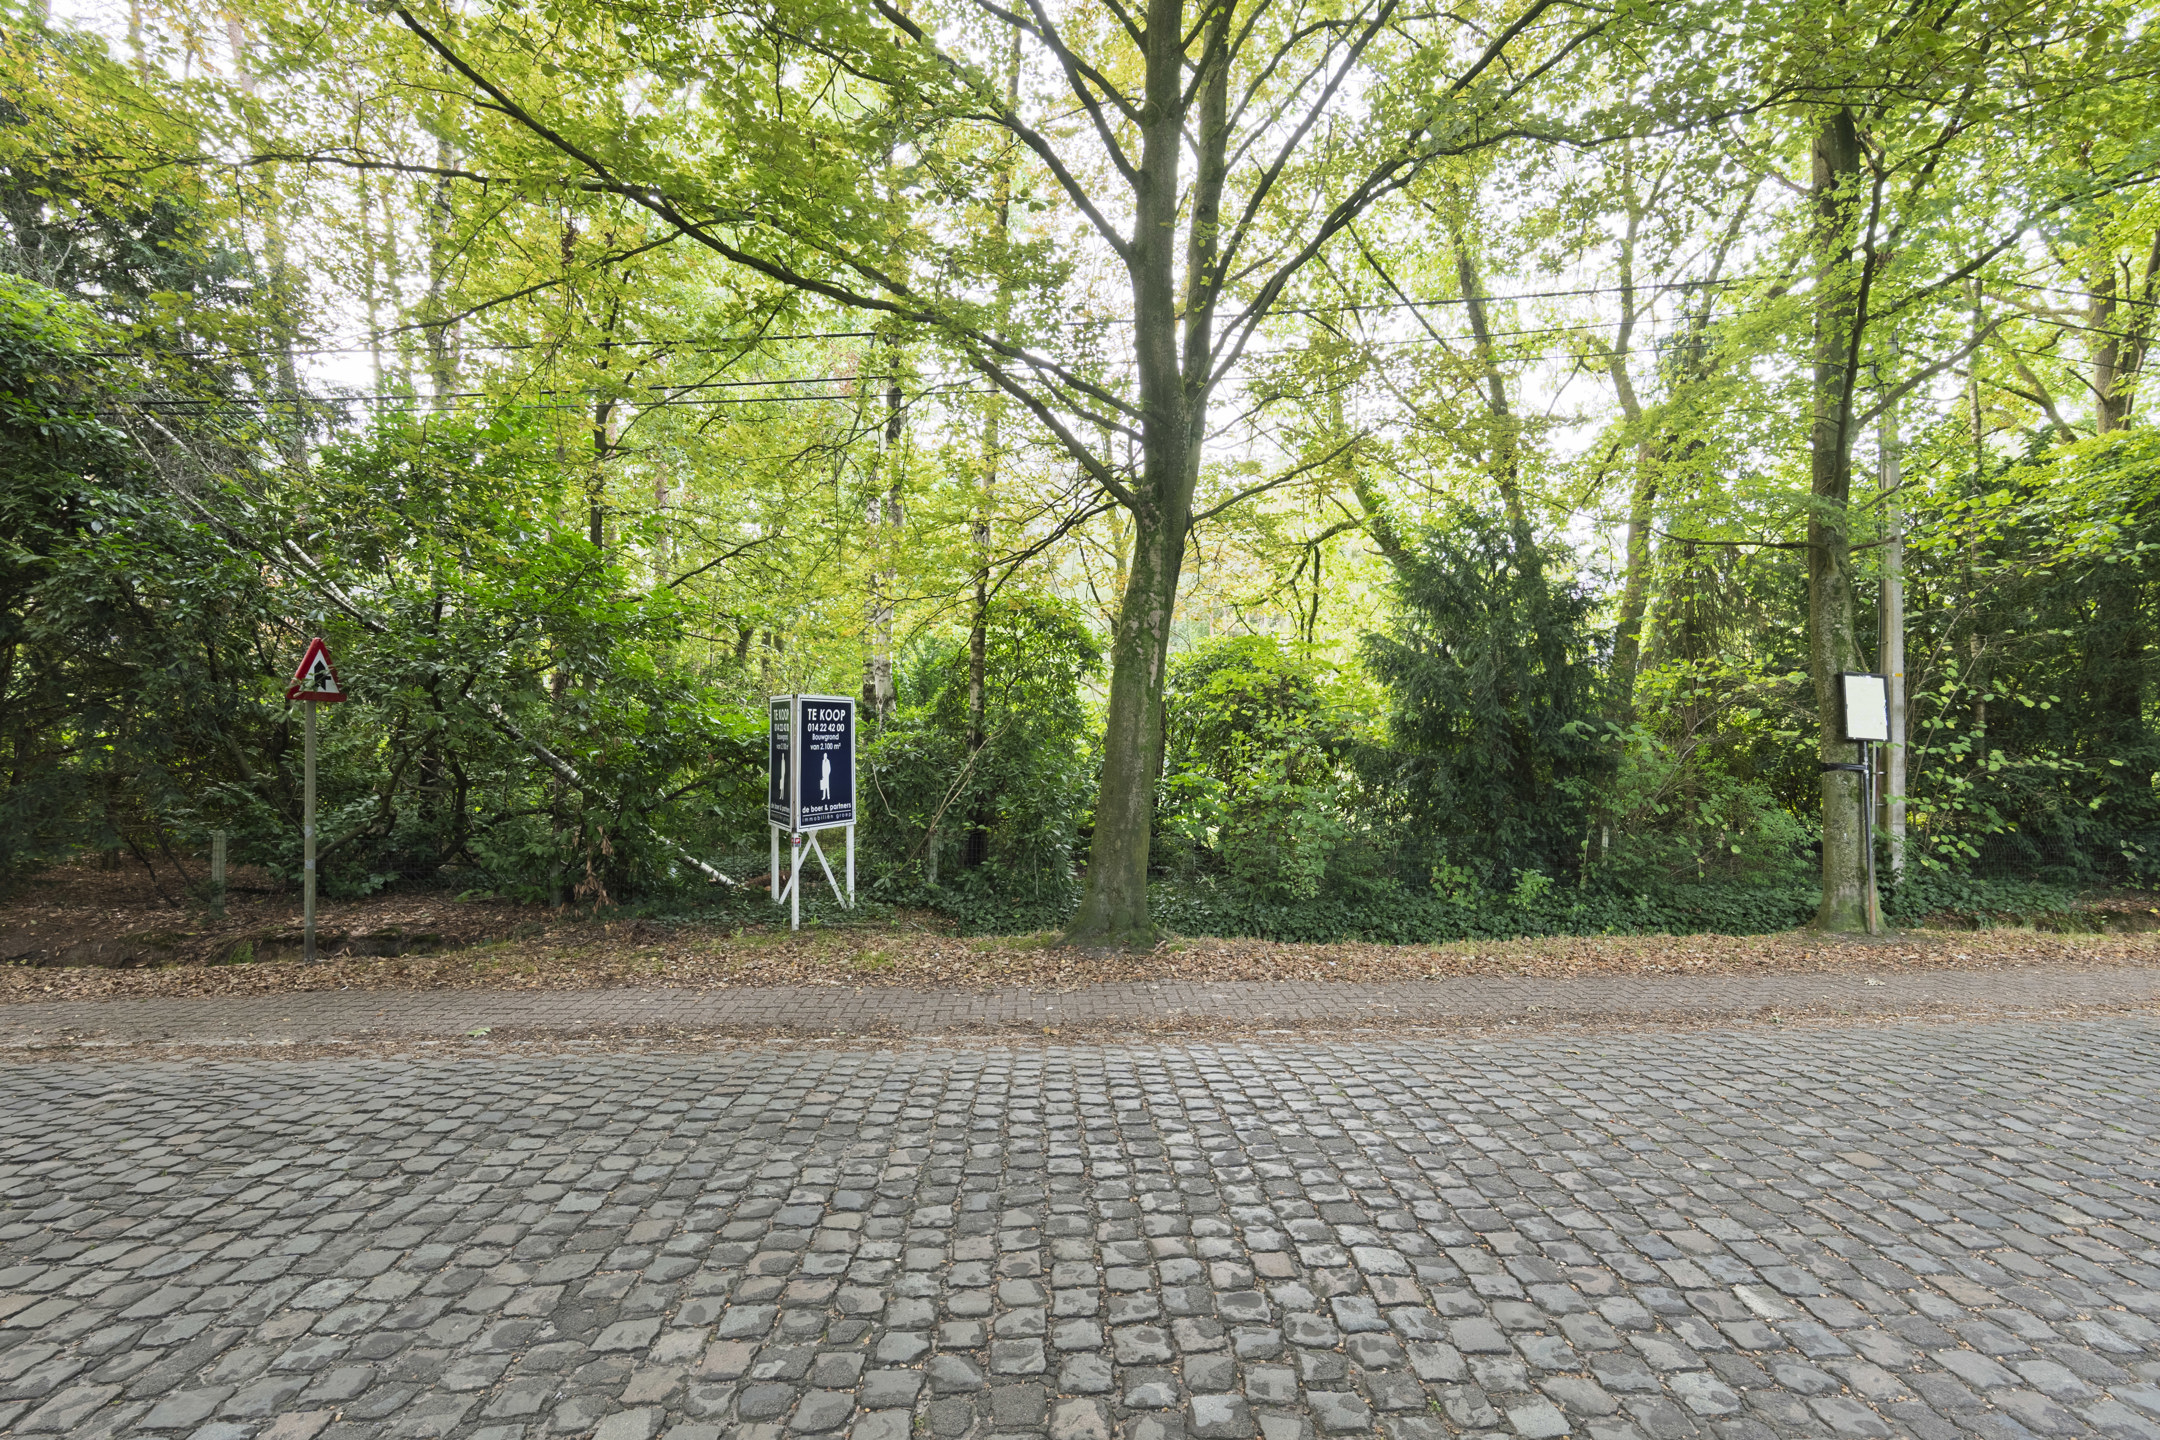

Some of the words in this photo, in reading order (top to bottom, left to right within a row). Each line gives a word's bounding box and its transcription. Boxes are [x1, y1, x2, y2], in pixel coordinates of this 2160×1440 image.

[807, 708, 817, 721] TE
[819, 708, 846, 721] KOOP
[807, 723, 819, 732] 014
[819, 723, 827, 732] 22
[828, 723, 836, 732] 42
[836, 723, 845, 732] 00
[812, 733, 839, 742] Bouwgrond
[810, 805, 823, 813] boer
[829, 802, 851, 812] partners
